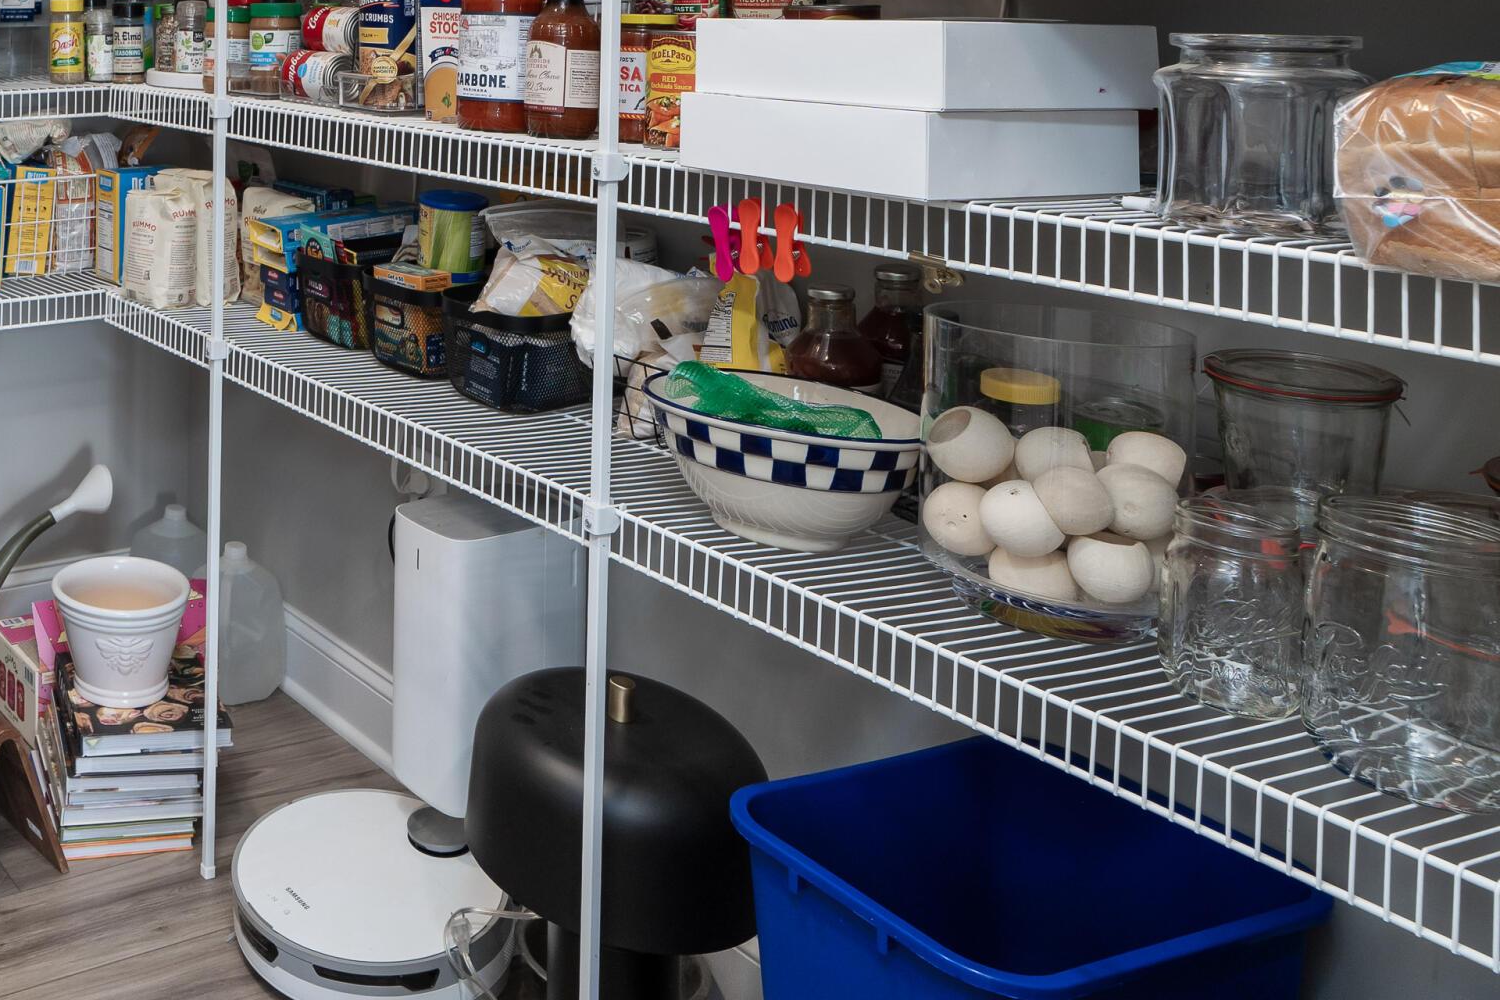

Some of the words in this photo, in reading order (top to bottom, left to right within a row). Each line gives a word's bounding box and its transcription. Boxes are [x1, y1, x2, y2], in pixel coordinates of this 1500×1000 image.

[307, 6, 331, 30] Camp
[364, 13, 394, 23] CRUMBS
[429, 21, 459, 34] STOC
[52, 37, 79, 52] Dash
[651, 50, 662, 61] OLD
[662, 49, 671, 58] EL
[457, 73, 507, 88] CARBONE
[661, 75, 677, 83] RED
[673, 82, 693, 90] Sauce
[205, 199, 236, 209] RMO
[172, 209, 197, 220] RUMM
[132, 219, 157, 232] RUMMO
[285, 887, 311, 910] SAMSUNG
